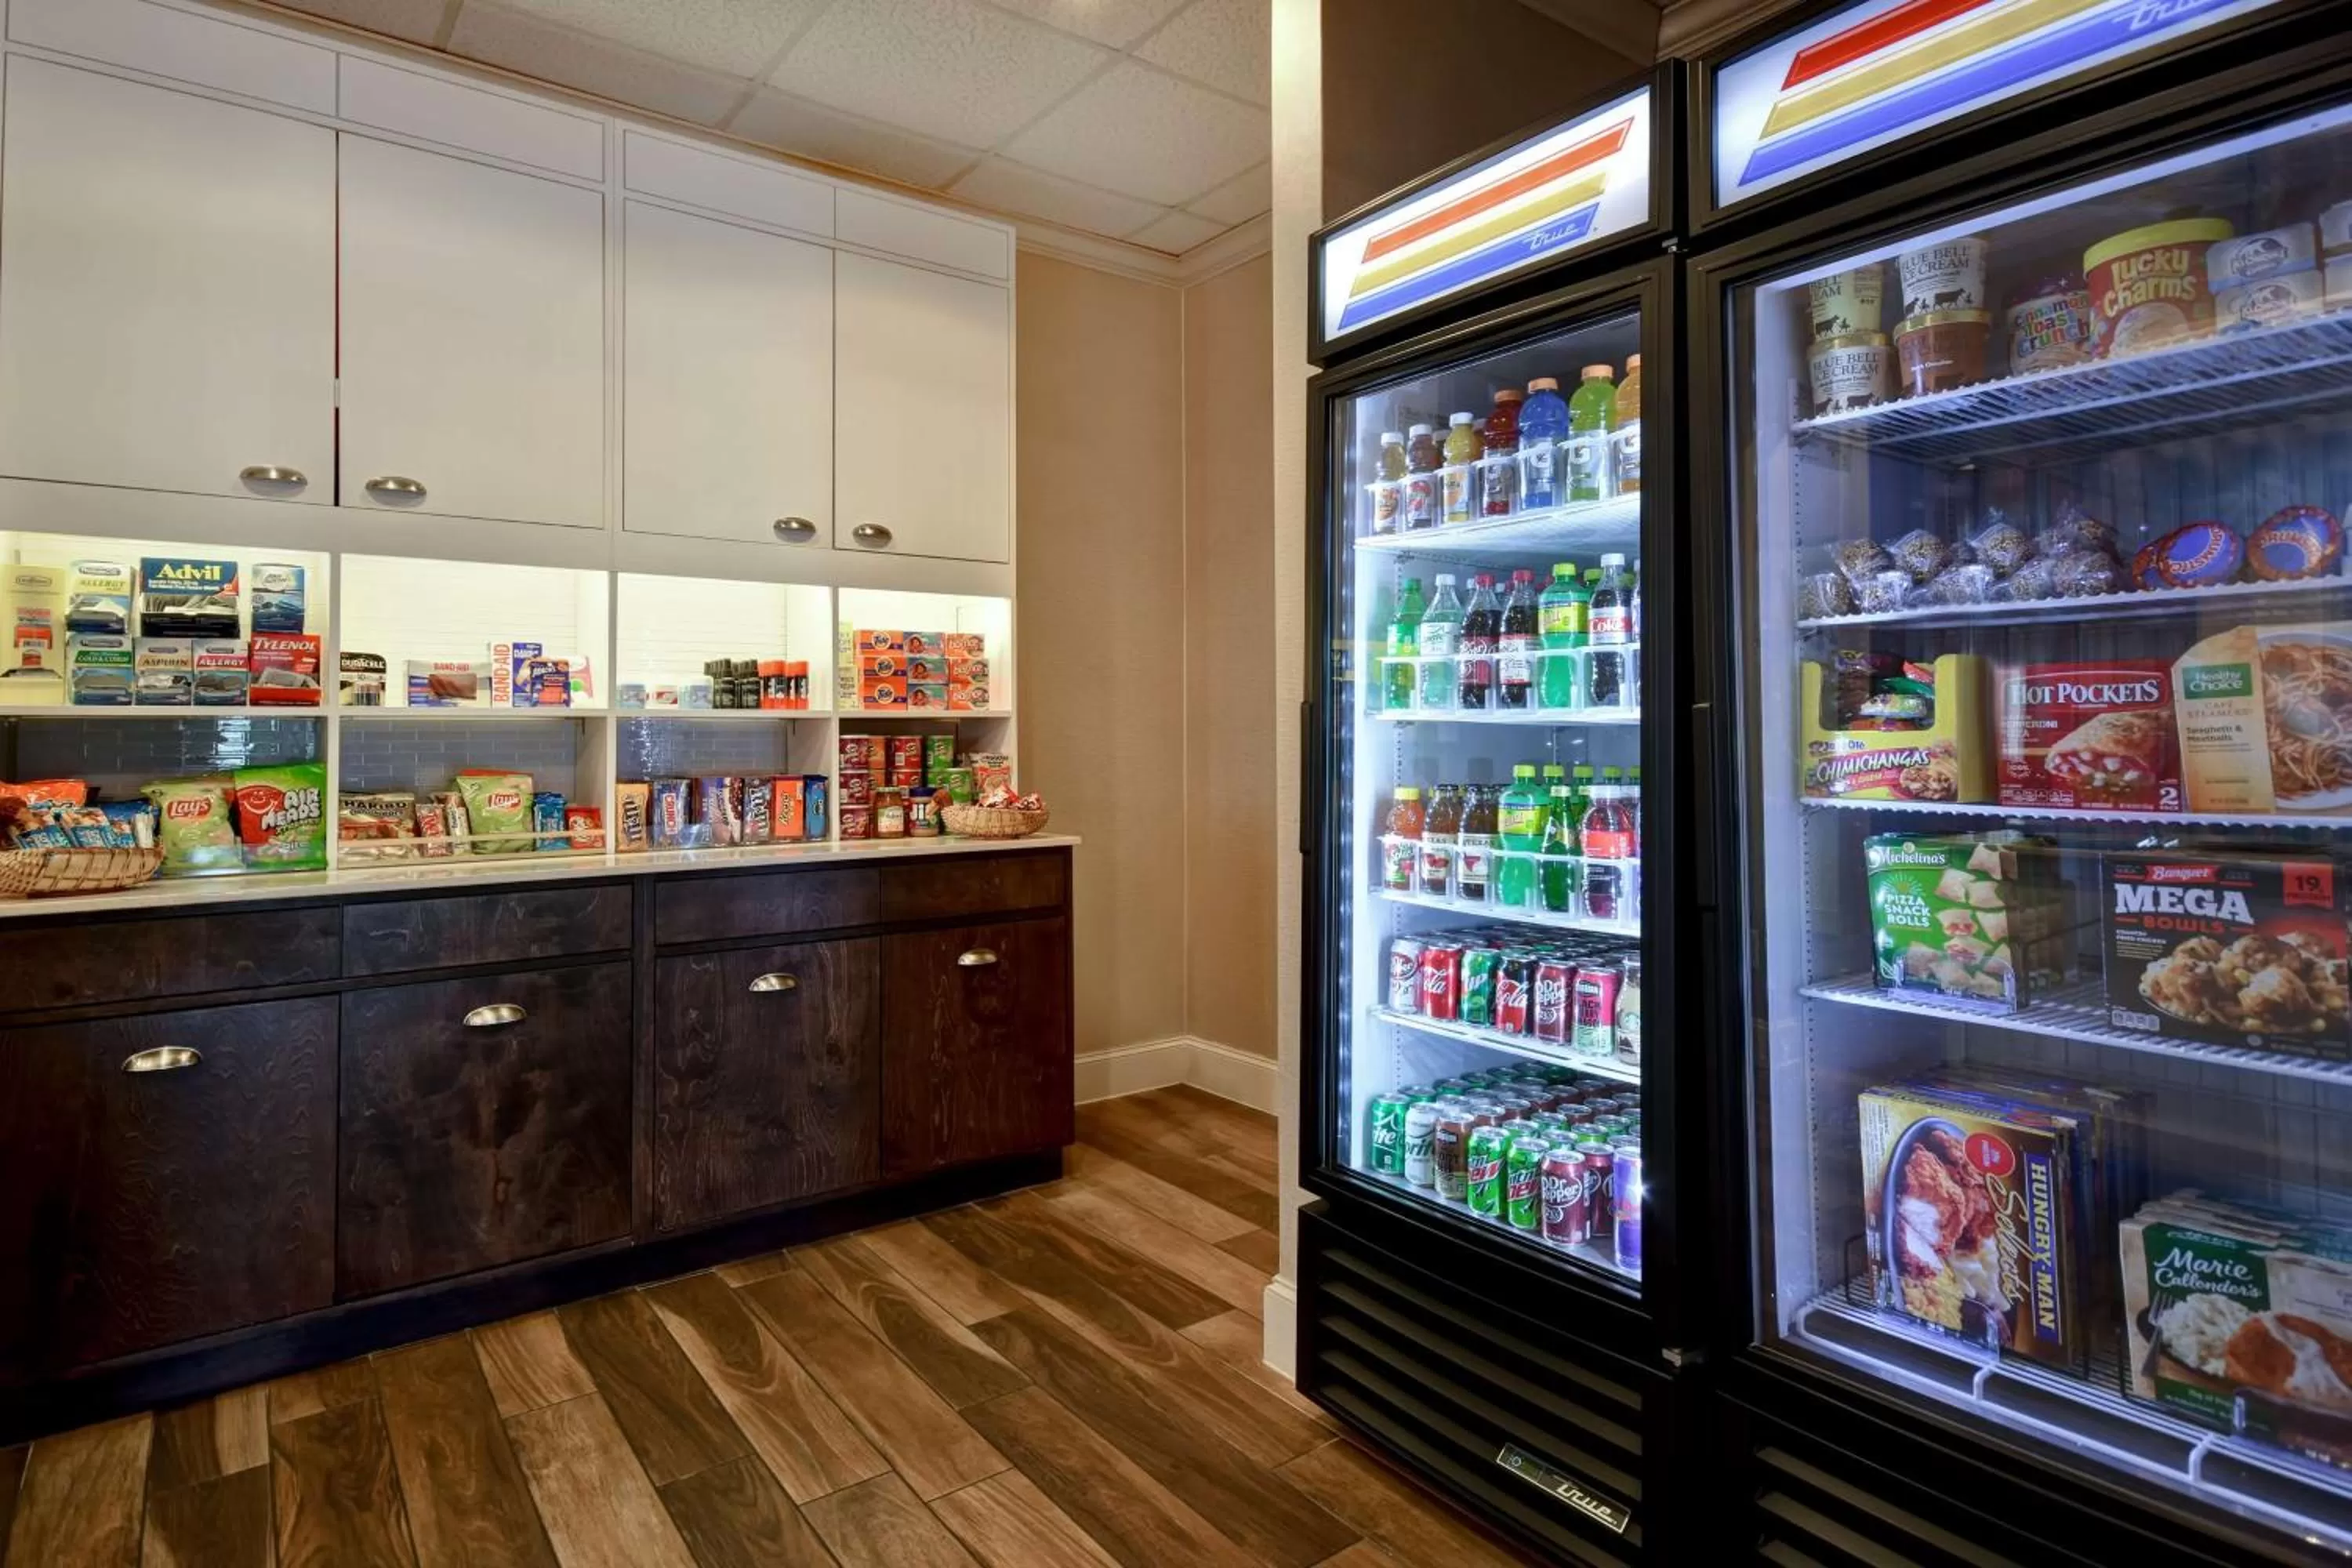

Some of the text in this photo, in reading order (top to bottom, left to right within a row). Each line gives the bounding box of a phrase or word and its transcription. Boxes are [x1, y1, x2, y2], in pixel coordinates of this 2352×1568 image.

[1846, 352, 1879, 365] BELL
[156, 563, 223, 581] Advil
[252, 637, 317, 652] TYLENOL
[493, 643, 511, 702] BAND-AID
[2056, 679, 2160, 704] POCKETS
[1817, 750, 1930, 783] CHIMICHANGAS
[284, 787, 320, 810] AIR
[343, 800, 408, 808] HARIBO
[2159, 786, 2179, 805] 2
[261, 801, 321, 831] HEADS
[1883, 903, 1932, 917] SNACK
[1886, 893, 1926, 906] PIZZA
[2113, 882, 2255, 926] MEGA
[1886, 914, 1931, 928] ROLLS
[2142, 914, 2227, 935] BOWLS
[1986, 1171, 2038, 1308] Selects
[2030, 1162, 2057, 1331] HUNGRY-MAN
[2152, 1246, 2253, 1281] Marie
